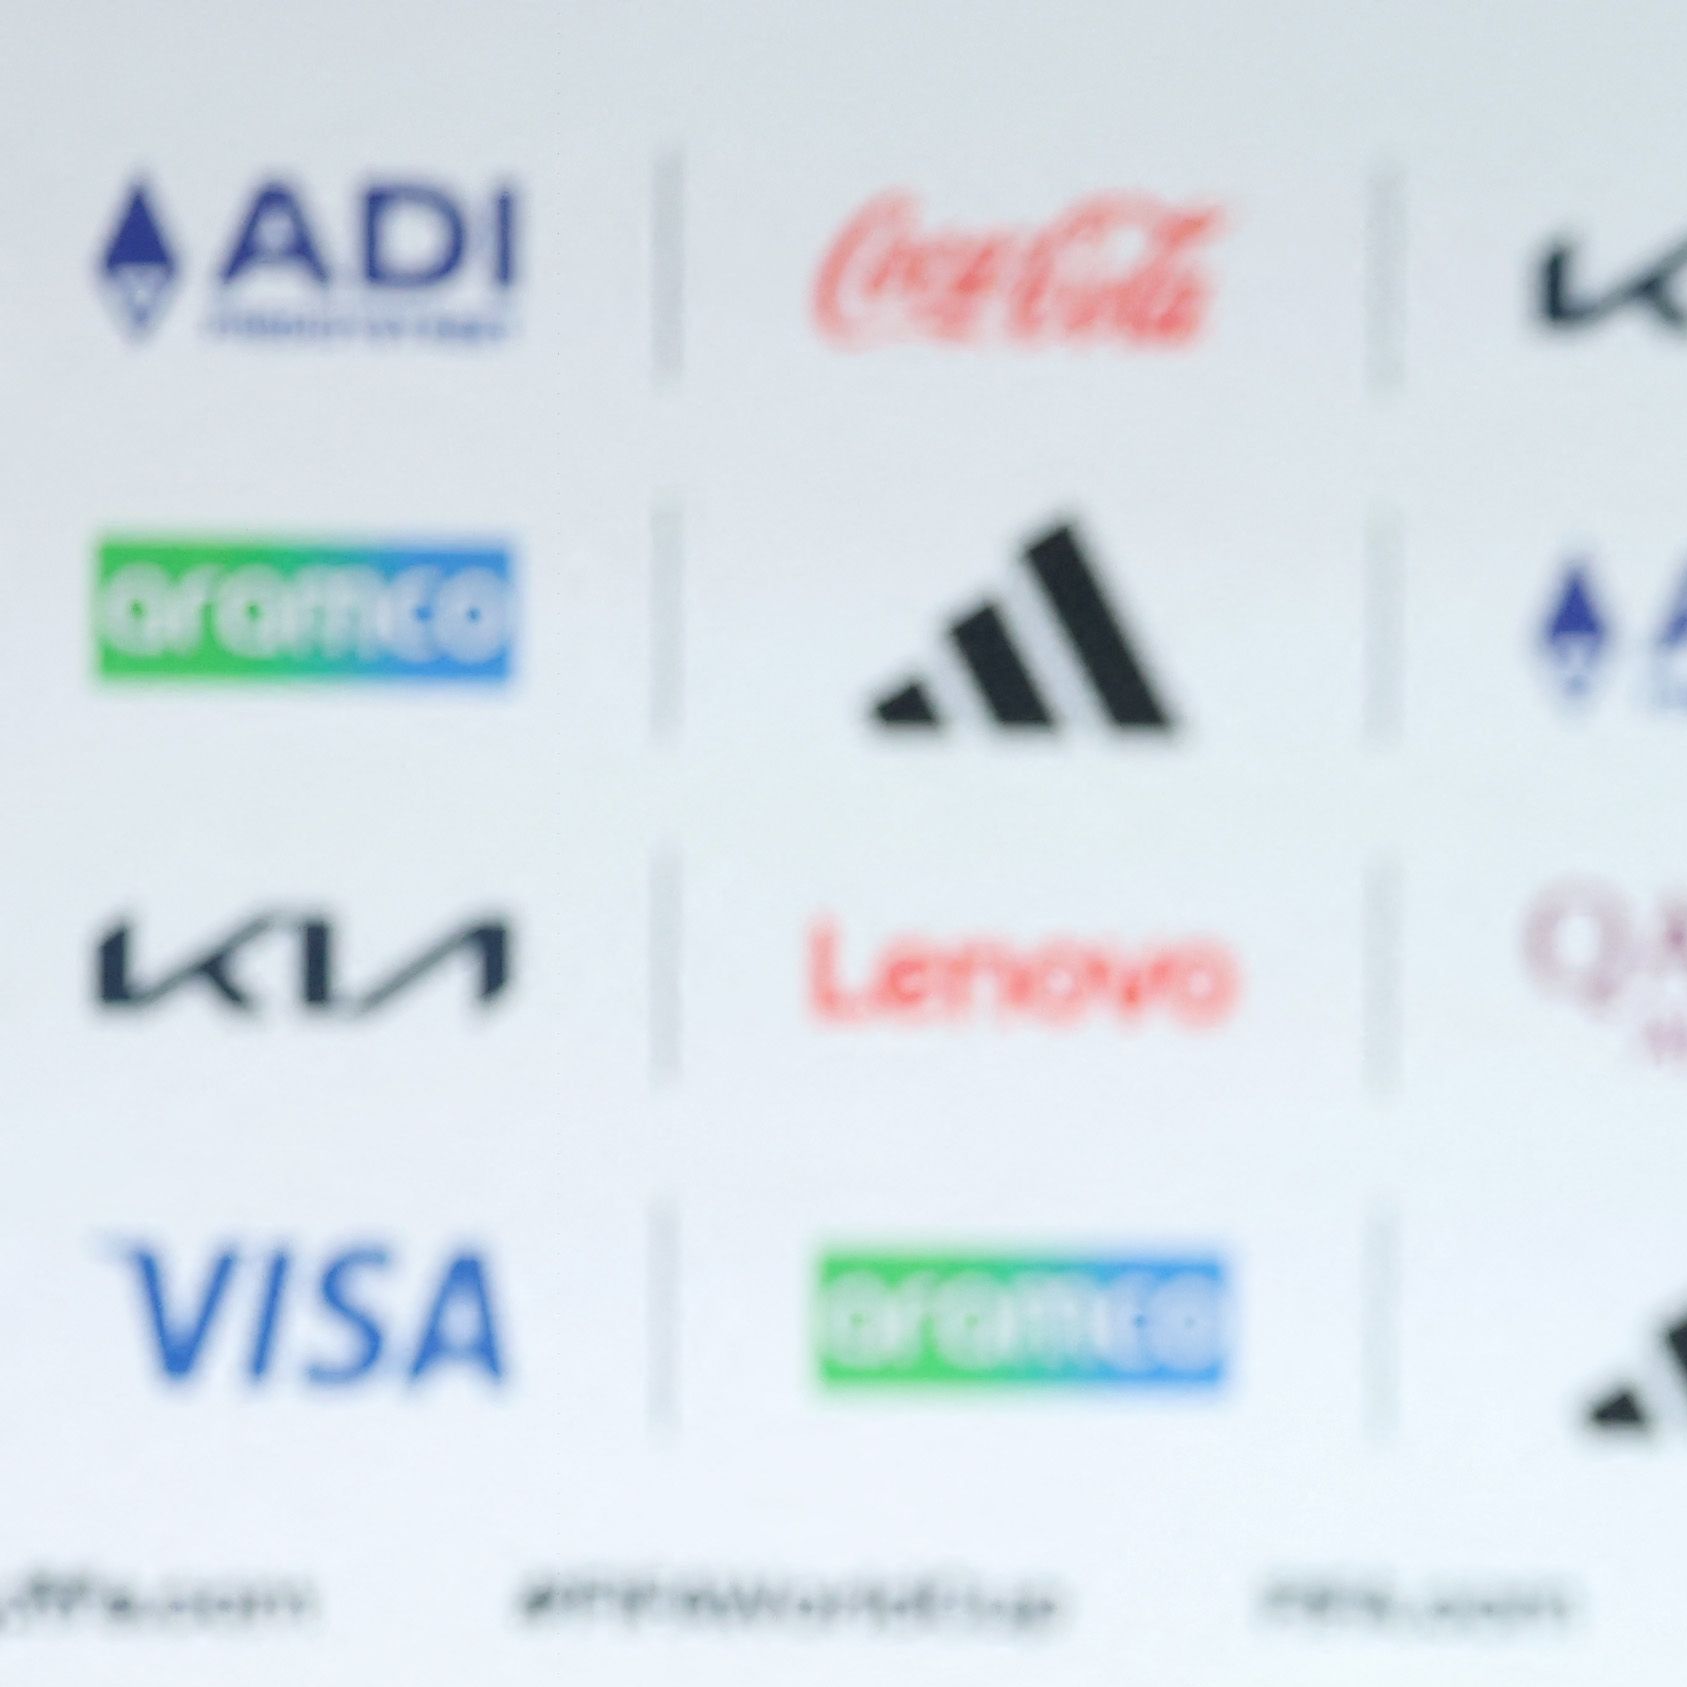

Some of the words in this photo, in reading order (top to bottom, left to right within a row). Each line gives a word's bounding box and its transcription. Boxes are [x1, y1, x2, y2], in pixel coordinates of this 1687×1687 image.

[214, 178, 519, 293] ADI
[104, 563, 512, 664] aramco
[93, 912, 514, 1015] KIA
[808, 914, 1238, 1024] Lenovo
[116, 1240, 508, 1388] VISA
[820, 1268, 1226, 1372] aramco
